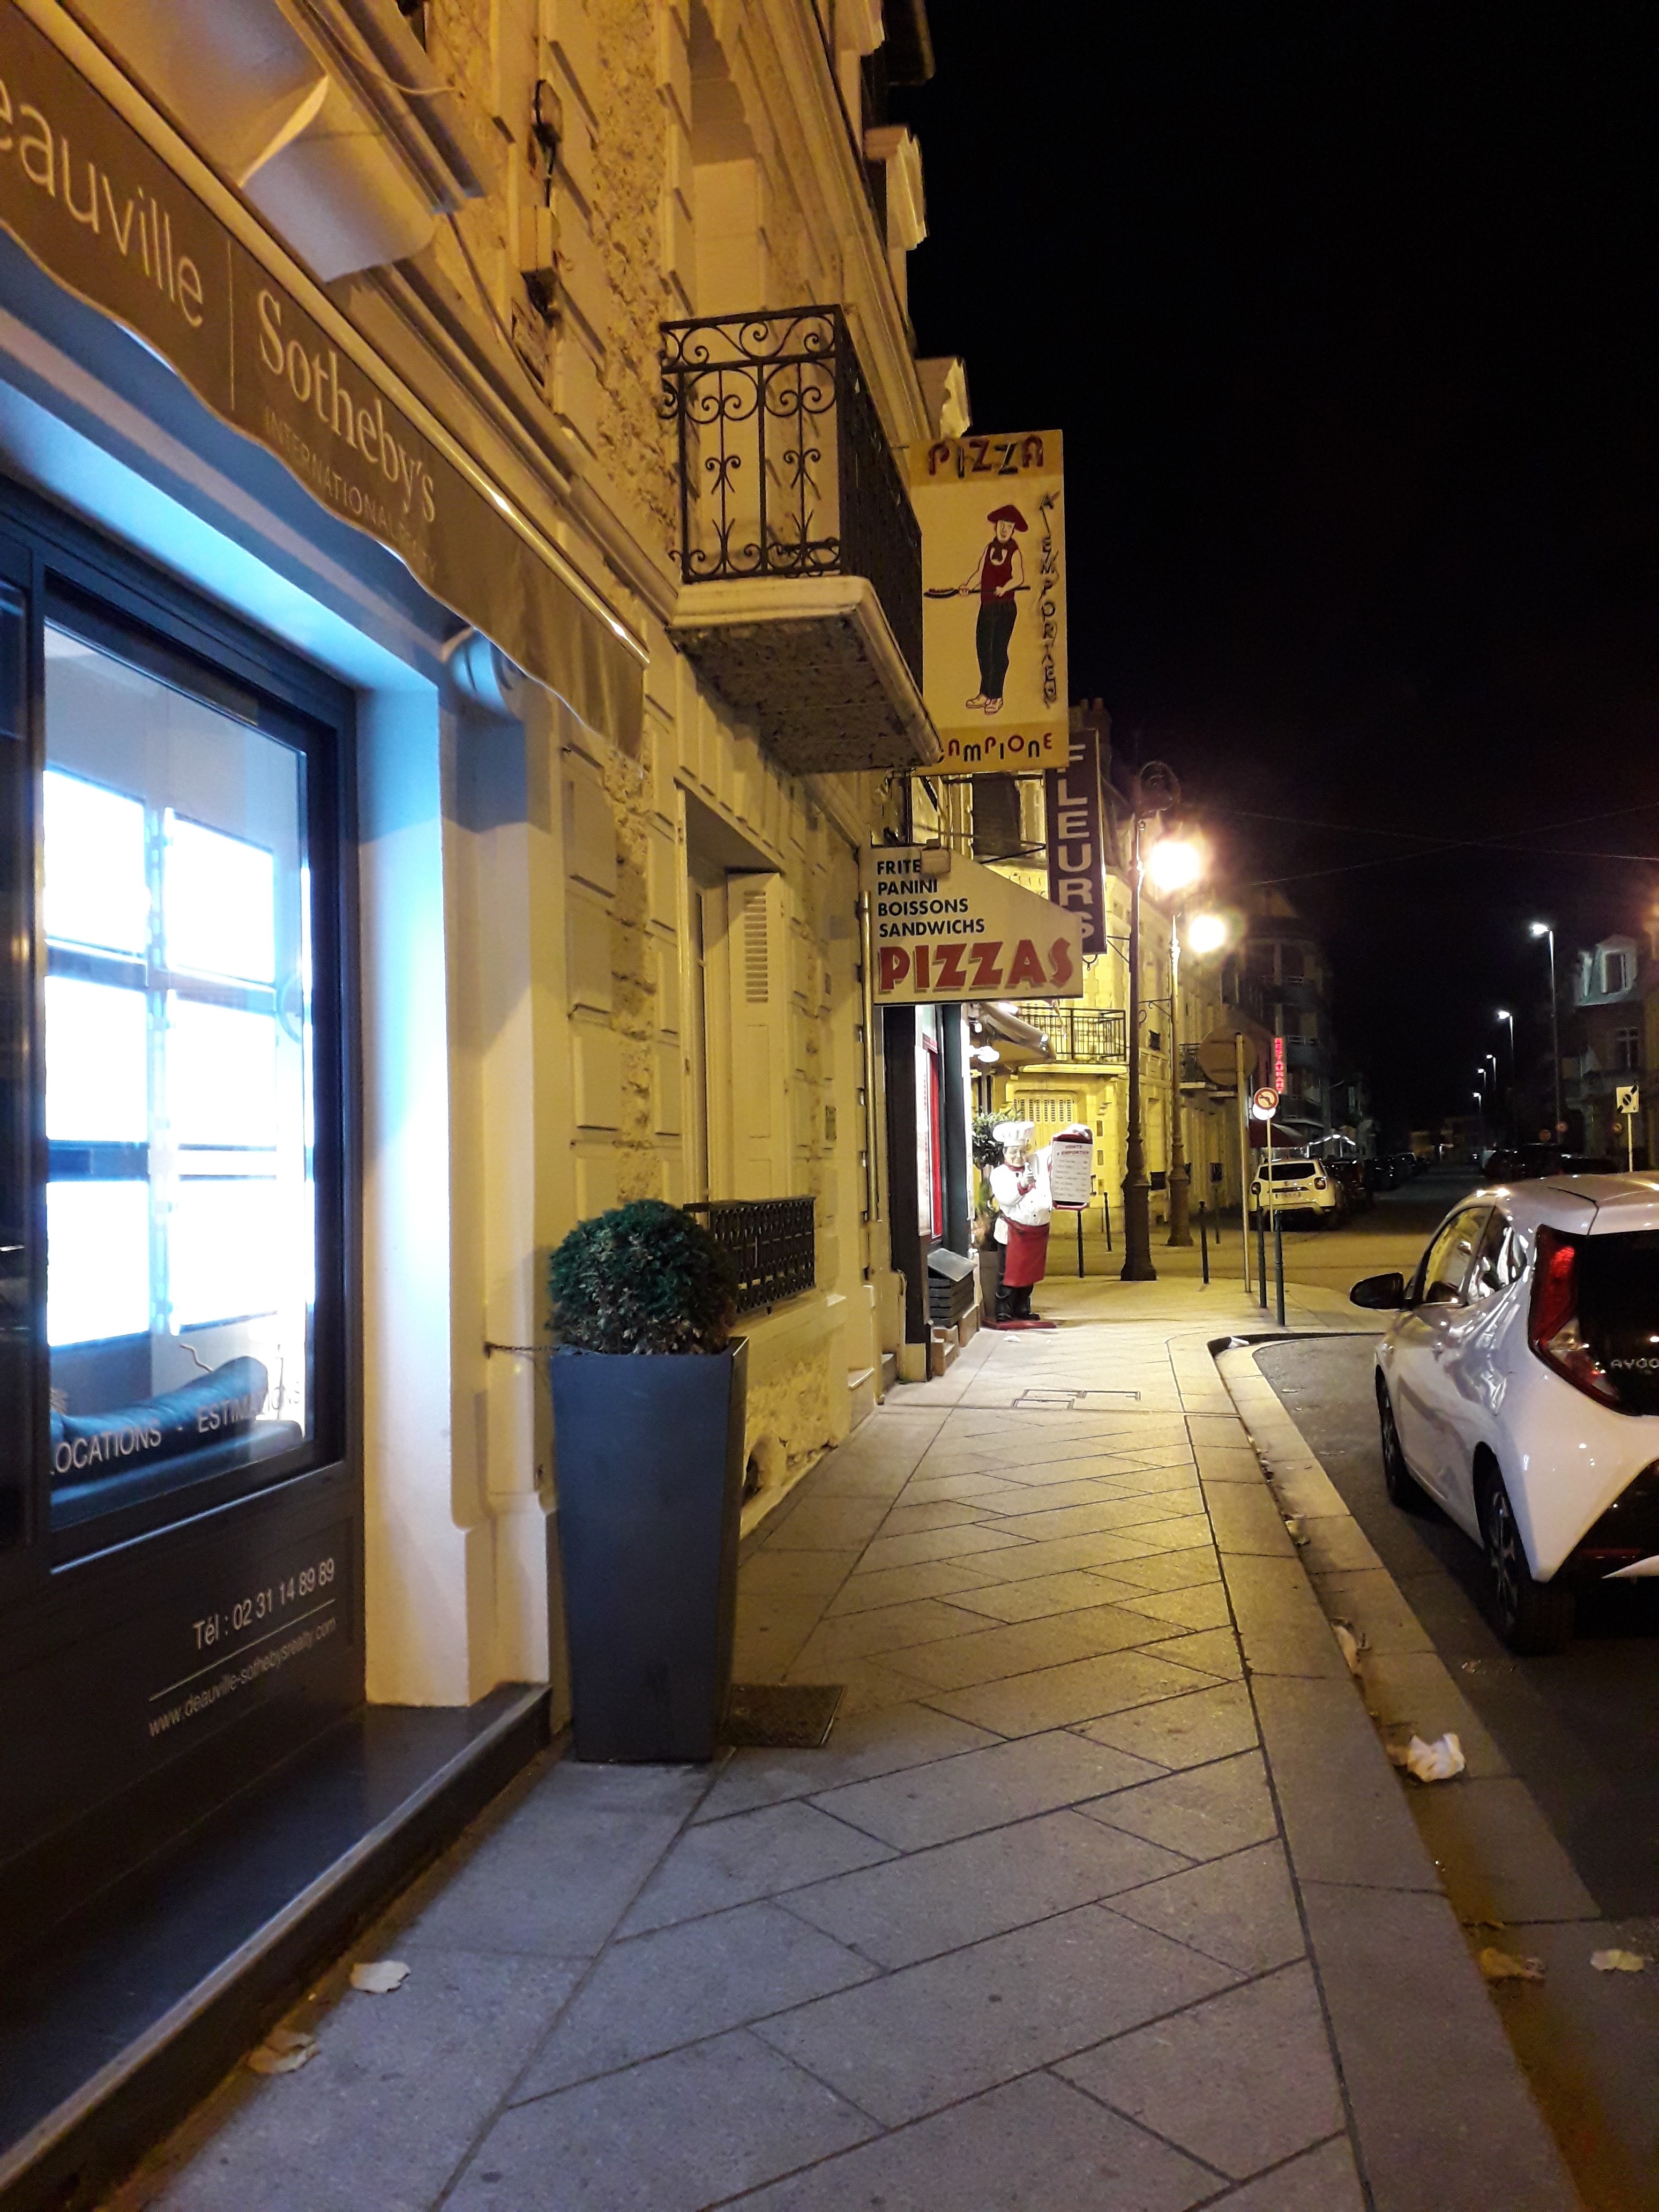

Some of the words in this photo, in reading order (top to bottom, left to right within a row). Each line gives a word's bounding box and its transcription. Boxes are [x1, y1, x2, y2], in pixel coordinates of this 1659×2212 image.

[258, 289, 435, 522] Sotheby's
[929, 435, 1044, 479] PIZZA
[878, 879, 938, 895] PANINI
[878, 898, 969, 916] BOISSONS
[879, 918, 985, 938] SANDWICHS
[878, 937, 1072, 993] PIZZAS
[51, 1426, 161, 1473] OCATIONS
[193, 1613, 219, 1649] Tél
[233, 1598, 252, 1630] 02
[256, 1588, 272, 1619] 31
[279, 1578, 294, 1605] 14
[299, 1567, 315, 1596] 89
[318, 1557, 334, 1586] 89
